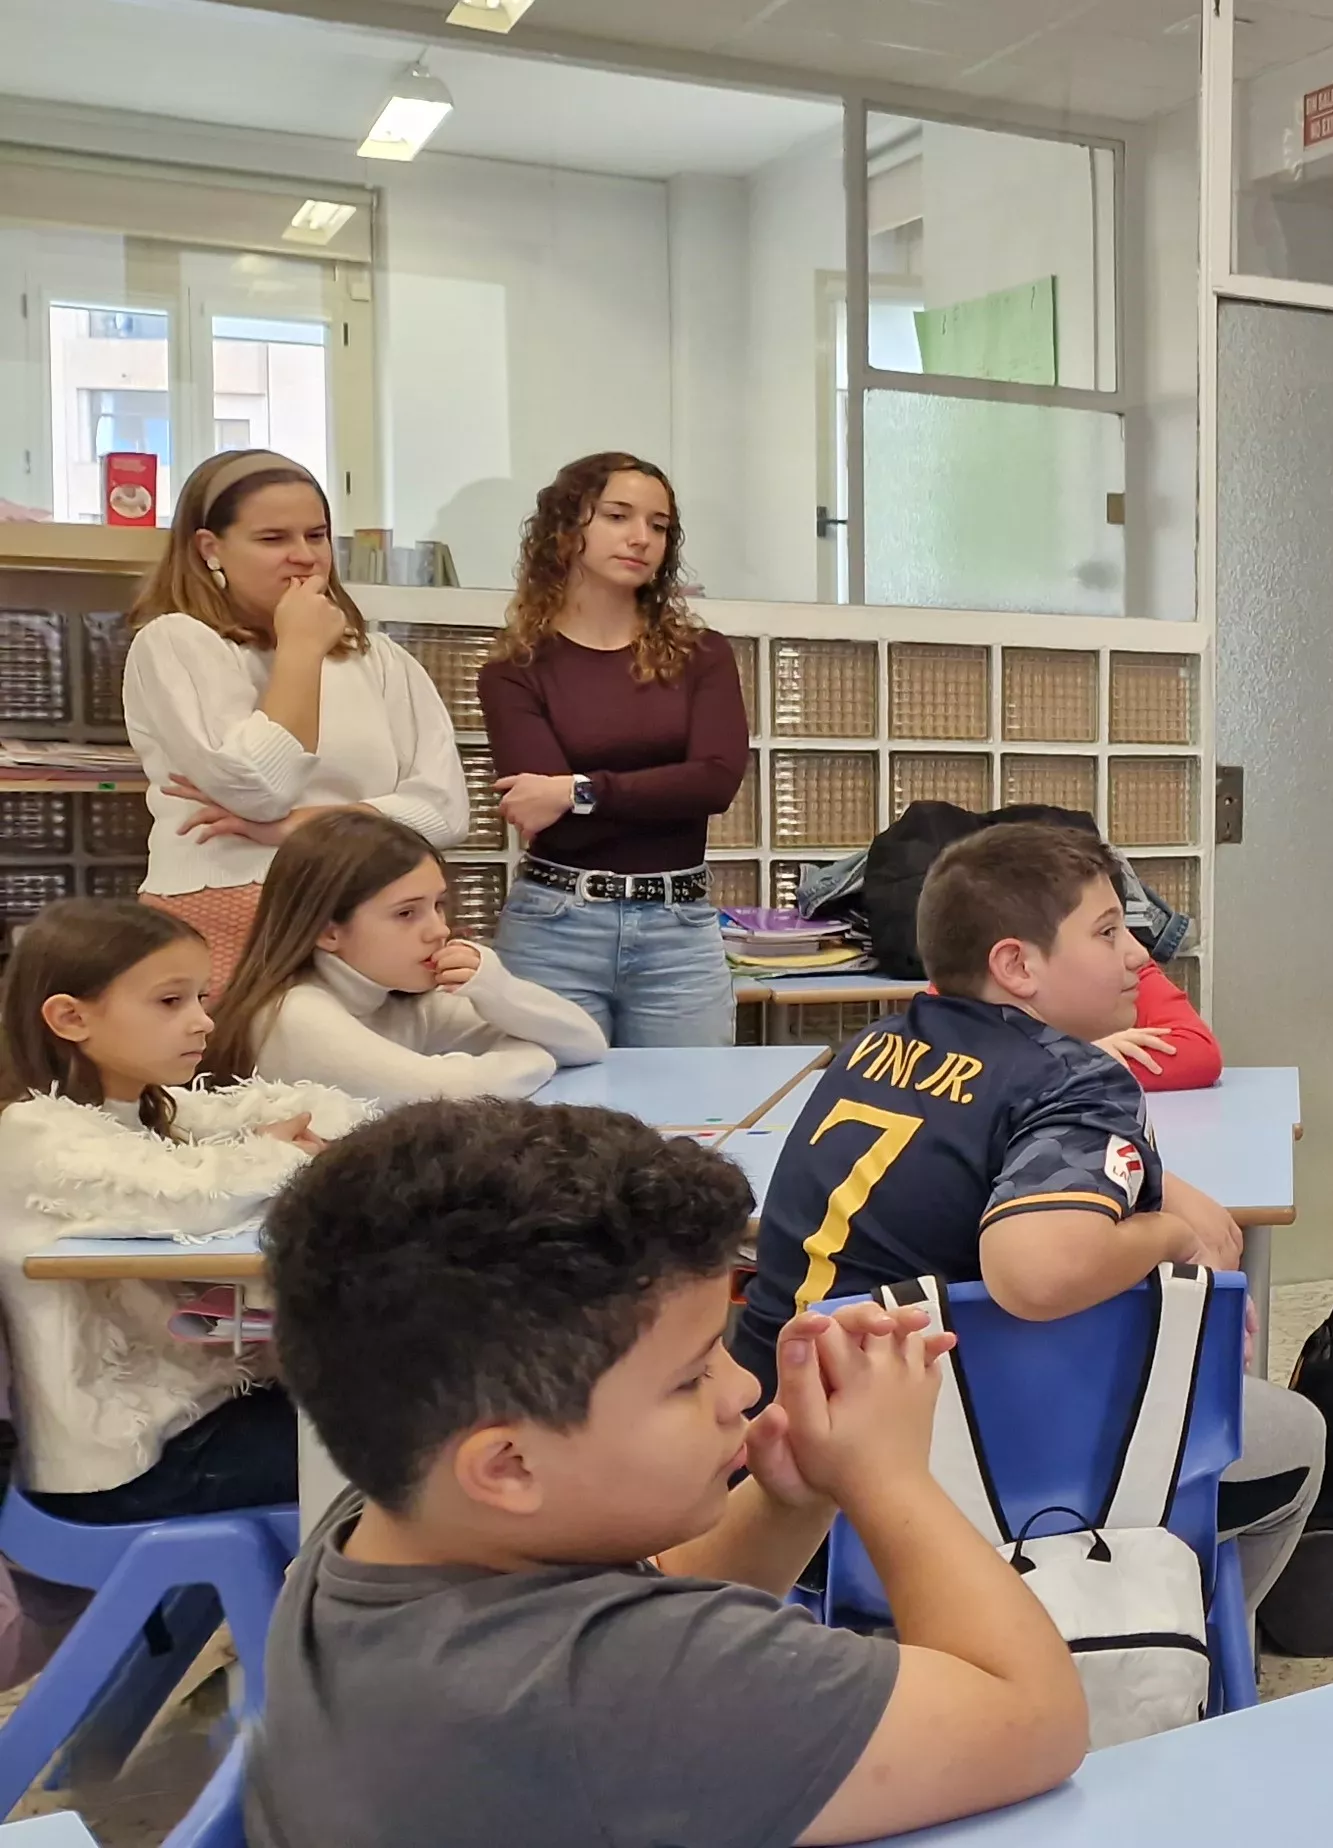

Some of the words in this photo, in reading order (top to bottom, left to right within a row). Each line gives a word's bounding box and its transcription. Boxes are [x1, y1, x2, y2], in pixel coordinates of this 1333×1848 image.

[1310, 119, 1320, 140] NO
[847, 1031, 931, 1089] VINI
[914, 1051, 984, 1104] JR.
[794, 1097, 924, 1316] 7
